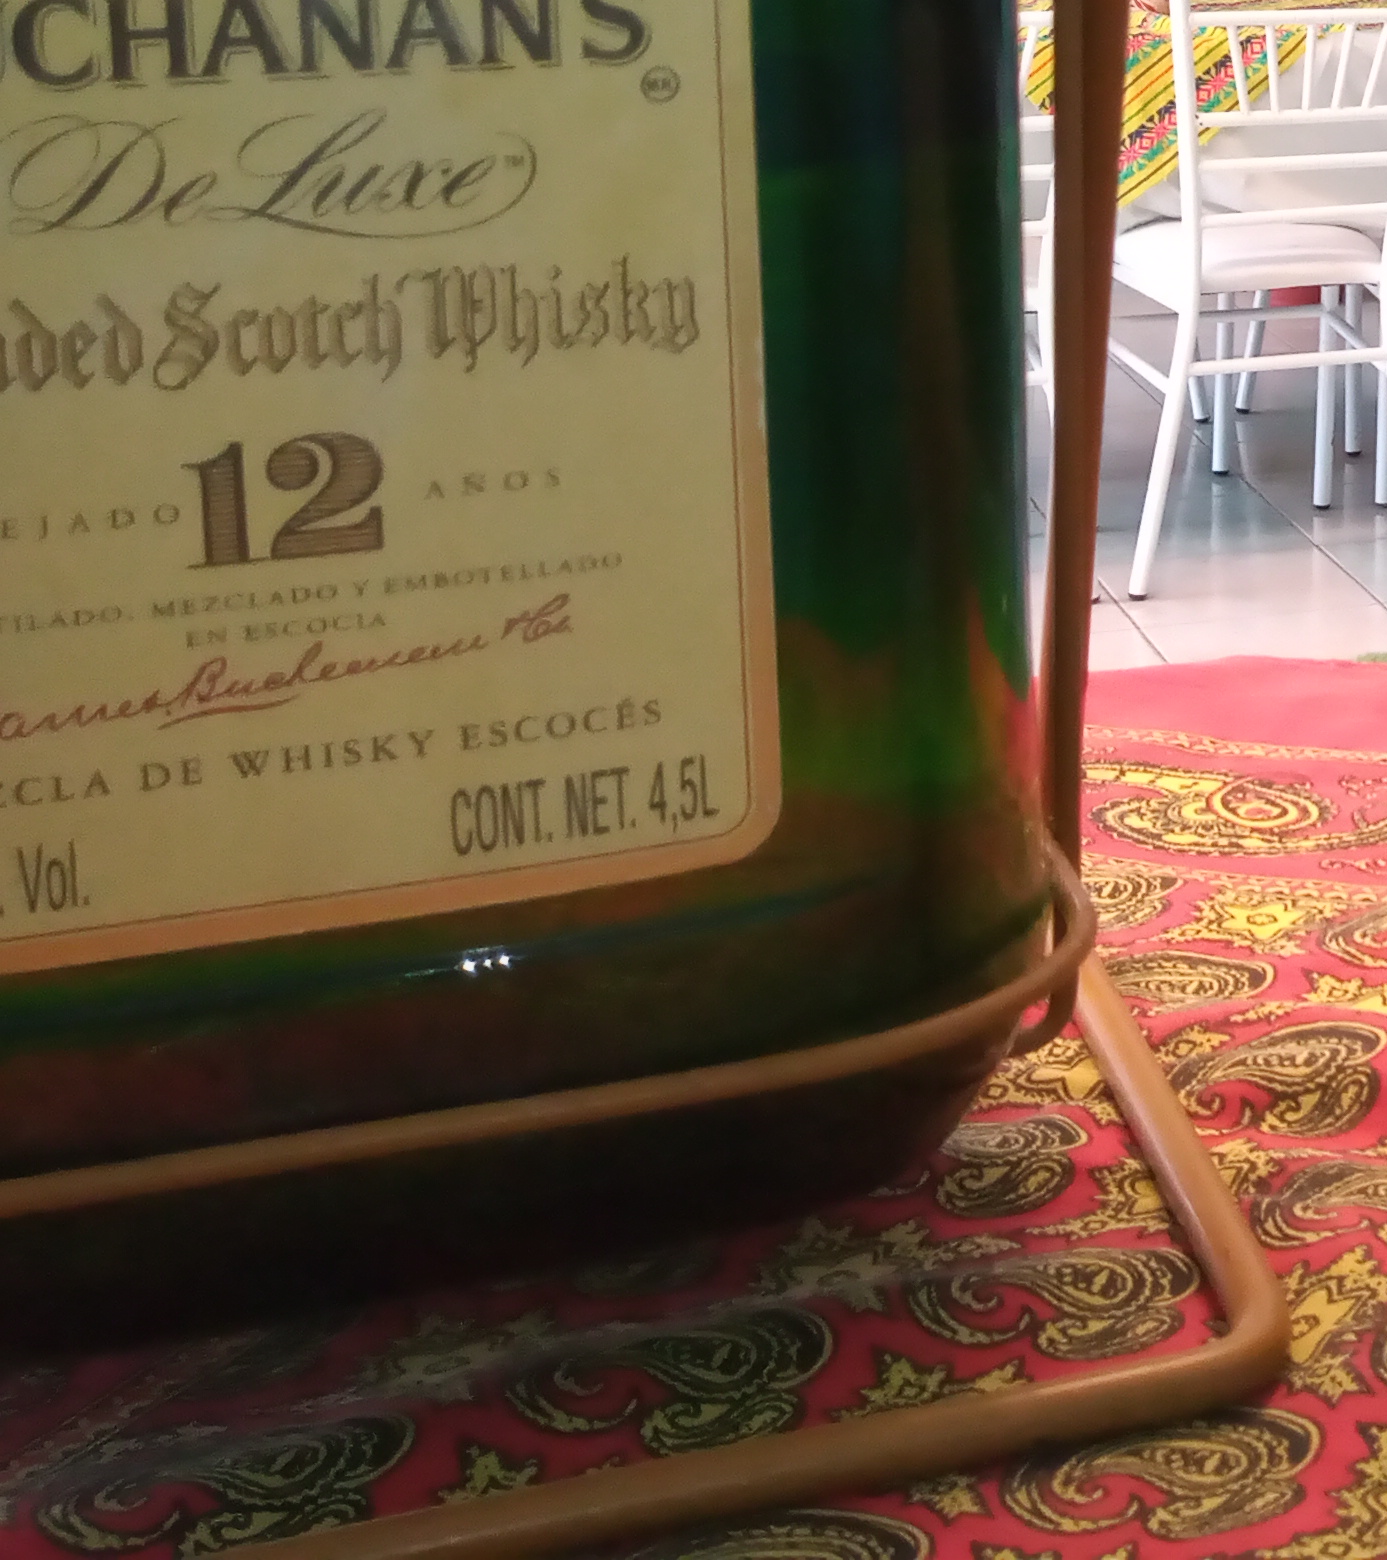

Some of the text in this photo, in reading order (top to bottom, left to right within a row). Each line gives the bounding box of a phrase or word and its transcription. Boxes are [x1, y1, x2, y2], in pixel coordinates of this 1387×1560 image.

[6, 108, 537, 239] De Luxe
[152, 272, 402, 395] Scotch
[402, 252, 700, 373] Whisky
[181, 431, 385, 571] 12
[243, 611, 387, 643] ESCOCIA
[383, 551, 623, 595] EMBOTELLADO
[0, 695, 663, 809] CLA DE WHISKY ESCOCÉS
[450, 752, 720, 857] CONT. NET. 4,5L
[16, 838, 91, 915] Vol.
